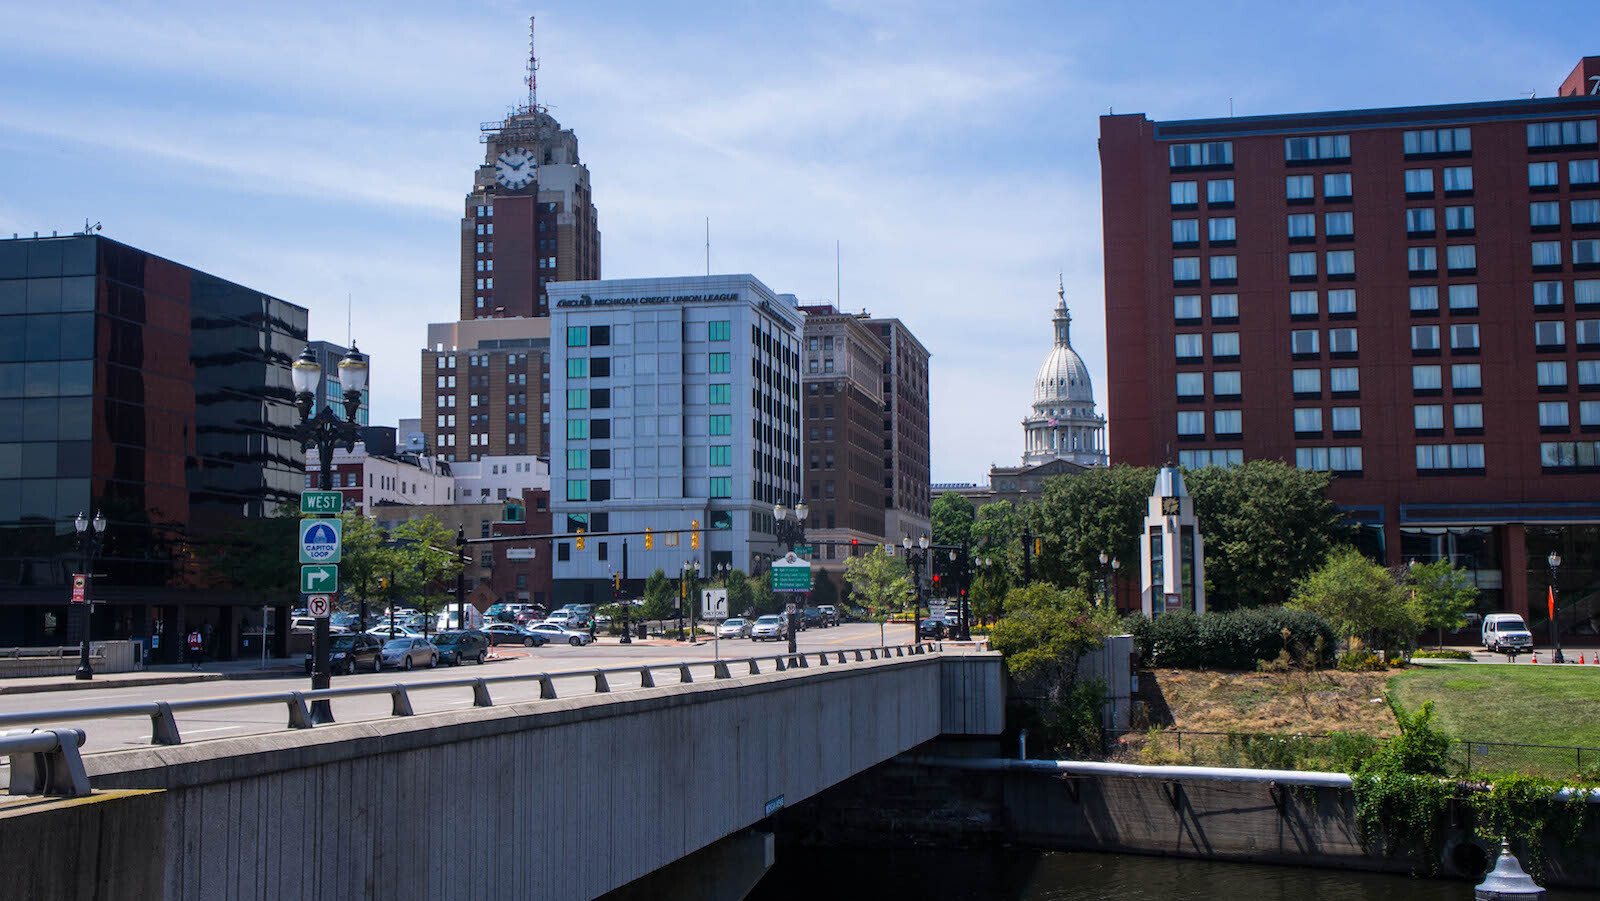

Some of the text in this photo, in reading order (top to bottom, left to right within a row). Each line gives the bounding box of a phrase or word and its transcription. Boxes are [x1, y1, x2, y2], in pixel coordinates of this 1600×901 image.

[594, 297, 638, 306] MICHIGAN
[639, 296, 671, 304] CREDIT
[673, 295, 702, 303] UNION
[704, 293, 739, 303] LEAGUE
[307, 496, 337, 508] WEST
